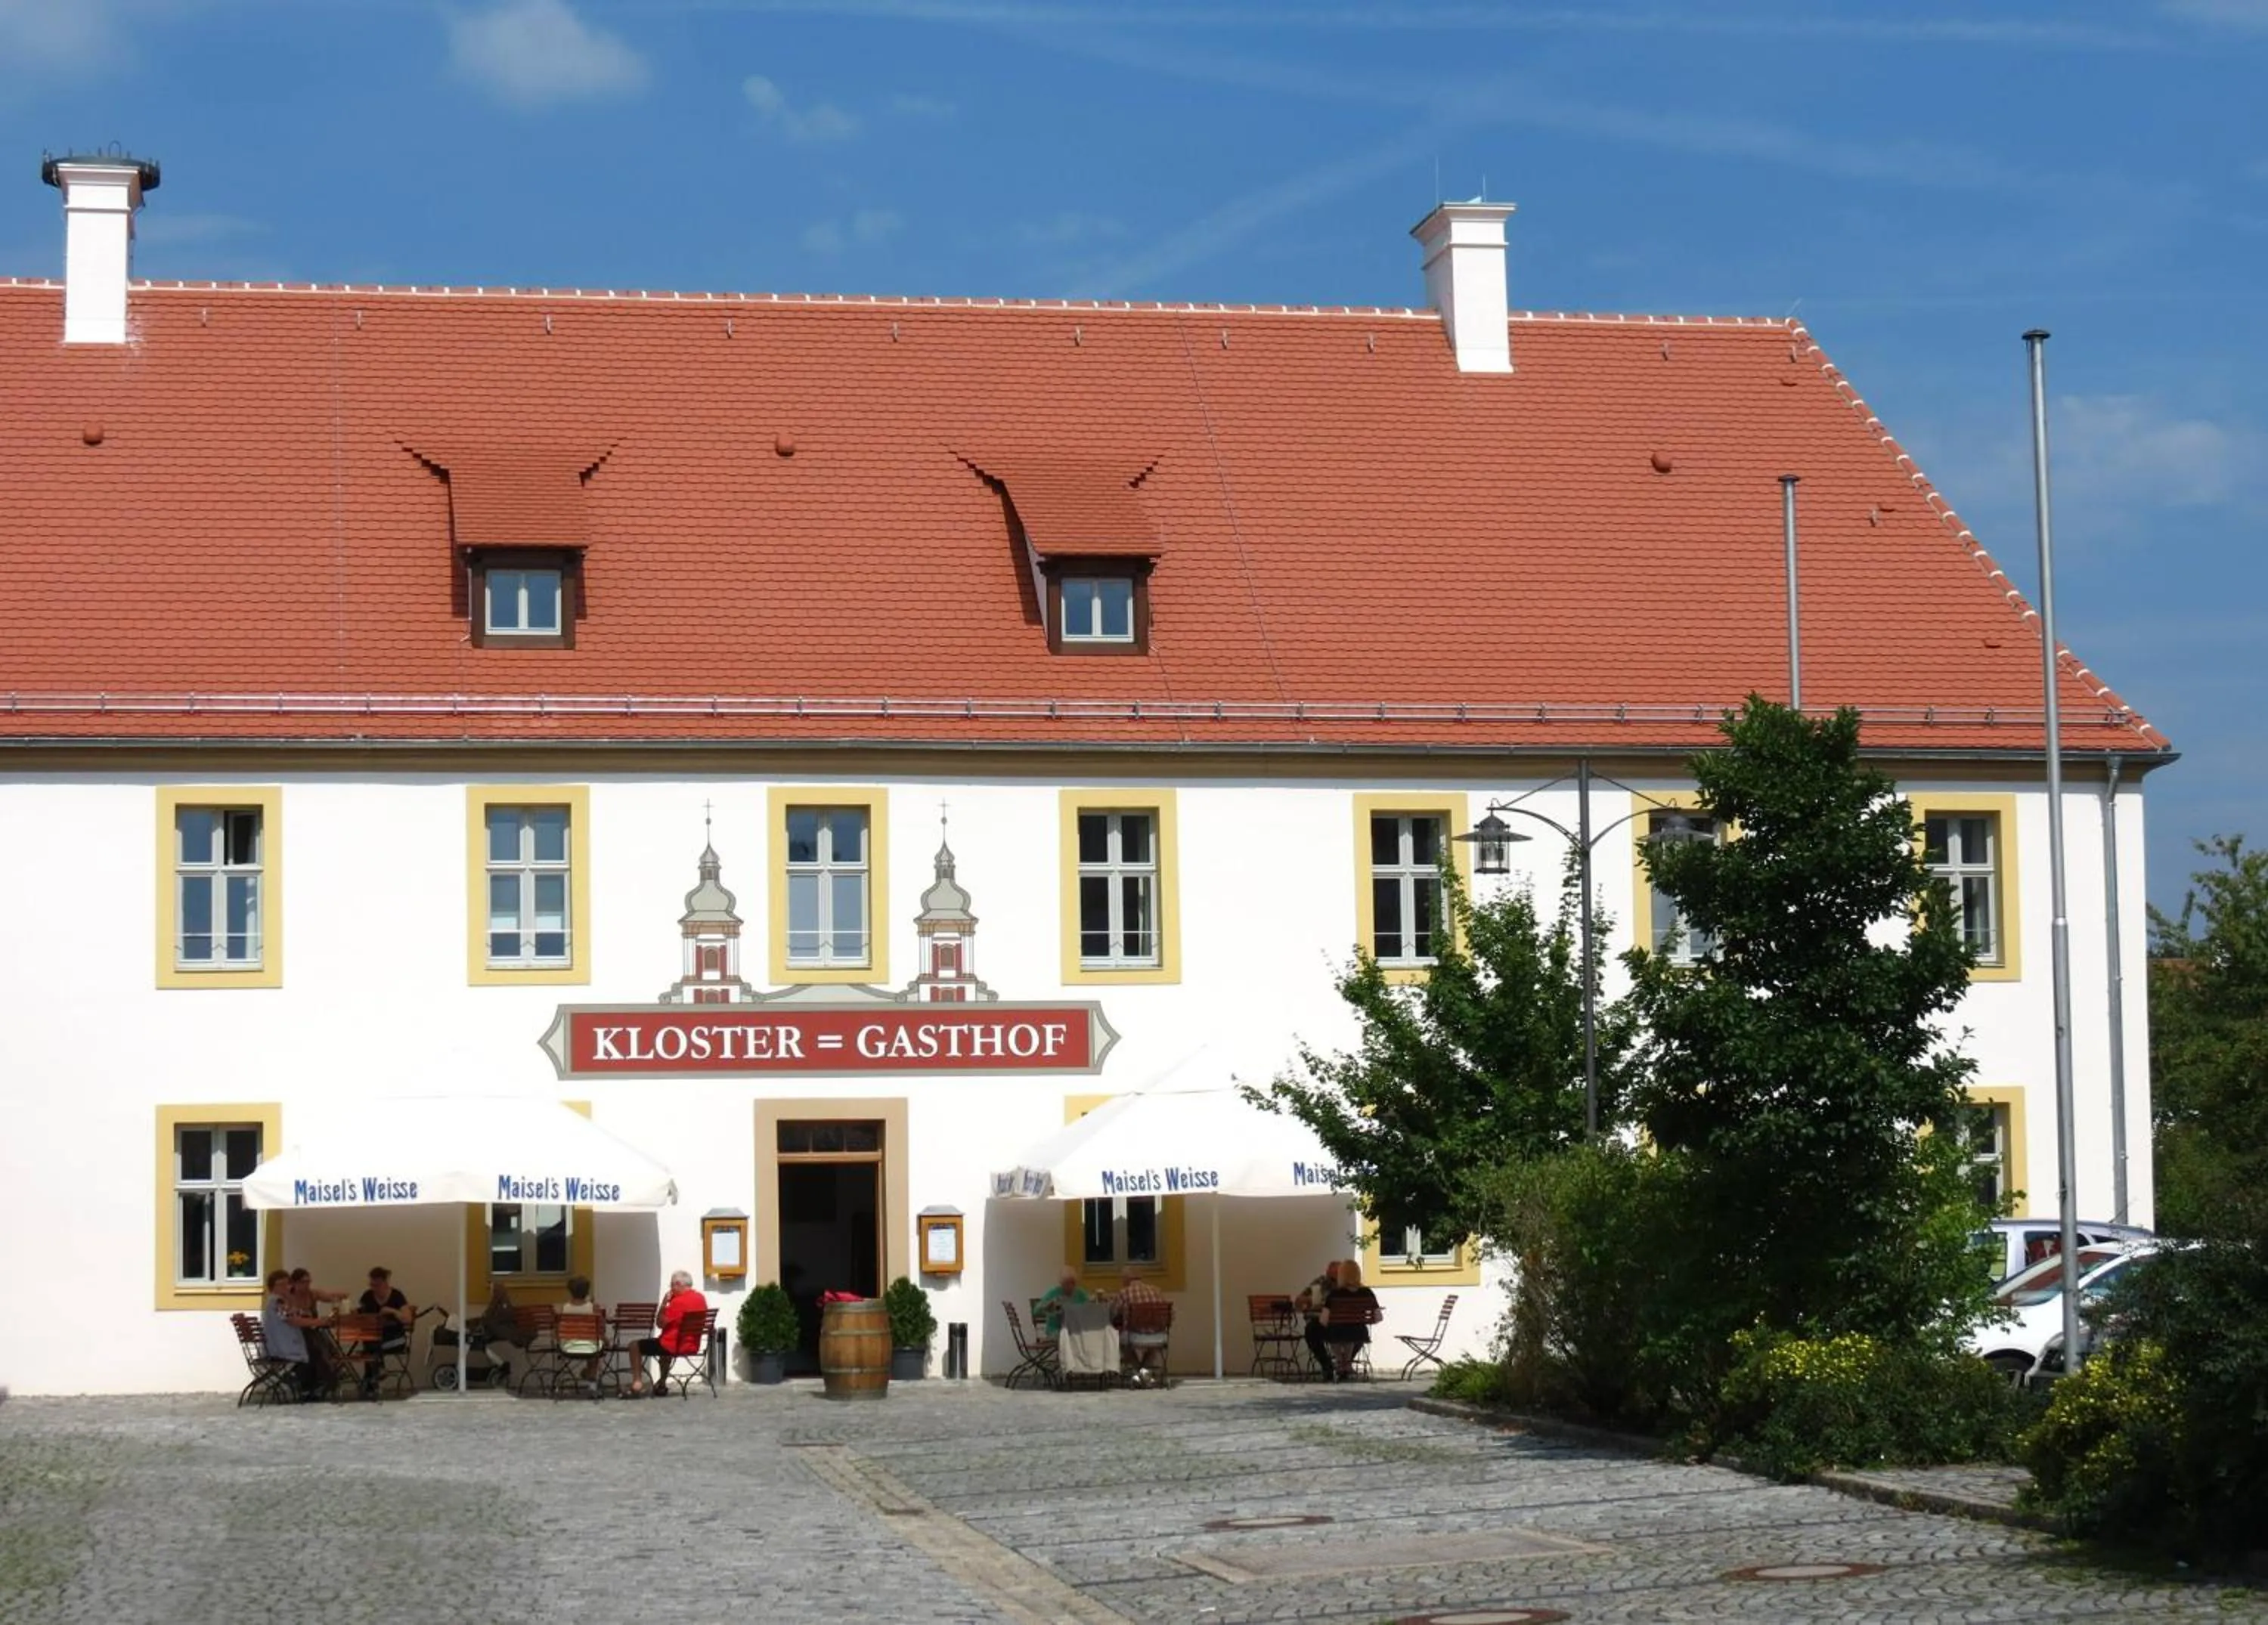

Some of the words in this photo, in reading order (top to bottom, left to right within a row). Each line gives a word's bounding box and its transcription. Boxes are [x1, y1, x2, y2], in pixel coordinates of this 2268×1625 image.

[592, 1026, 806, 1060] KLOSTER
[857, 1023, 1067, 1057] GASTHOF
[294, 1178, 357, 1206] Maisel's
[362, 1176, 418, 1202] Weisse
[497, 1175, 559, 1200] Maisel's
[565, 1177, 620, 1202] Weisse
[1101, 1169, 1161, 1194] Maisel's
[1165, 1166, 1219, 1192] Weisse
